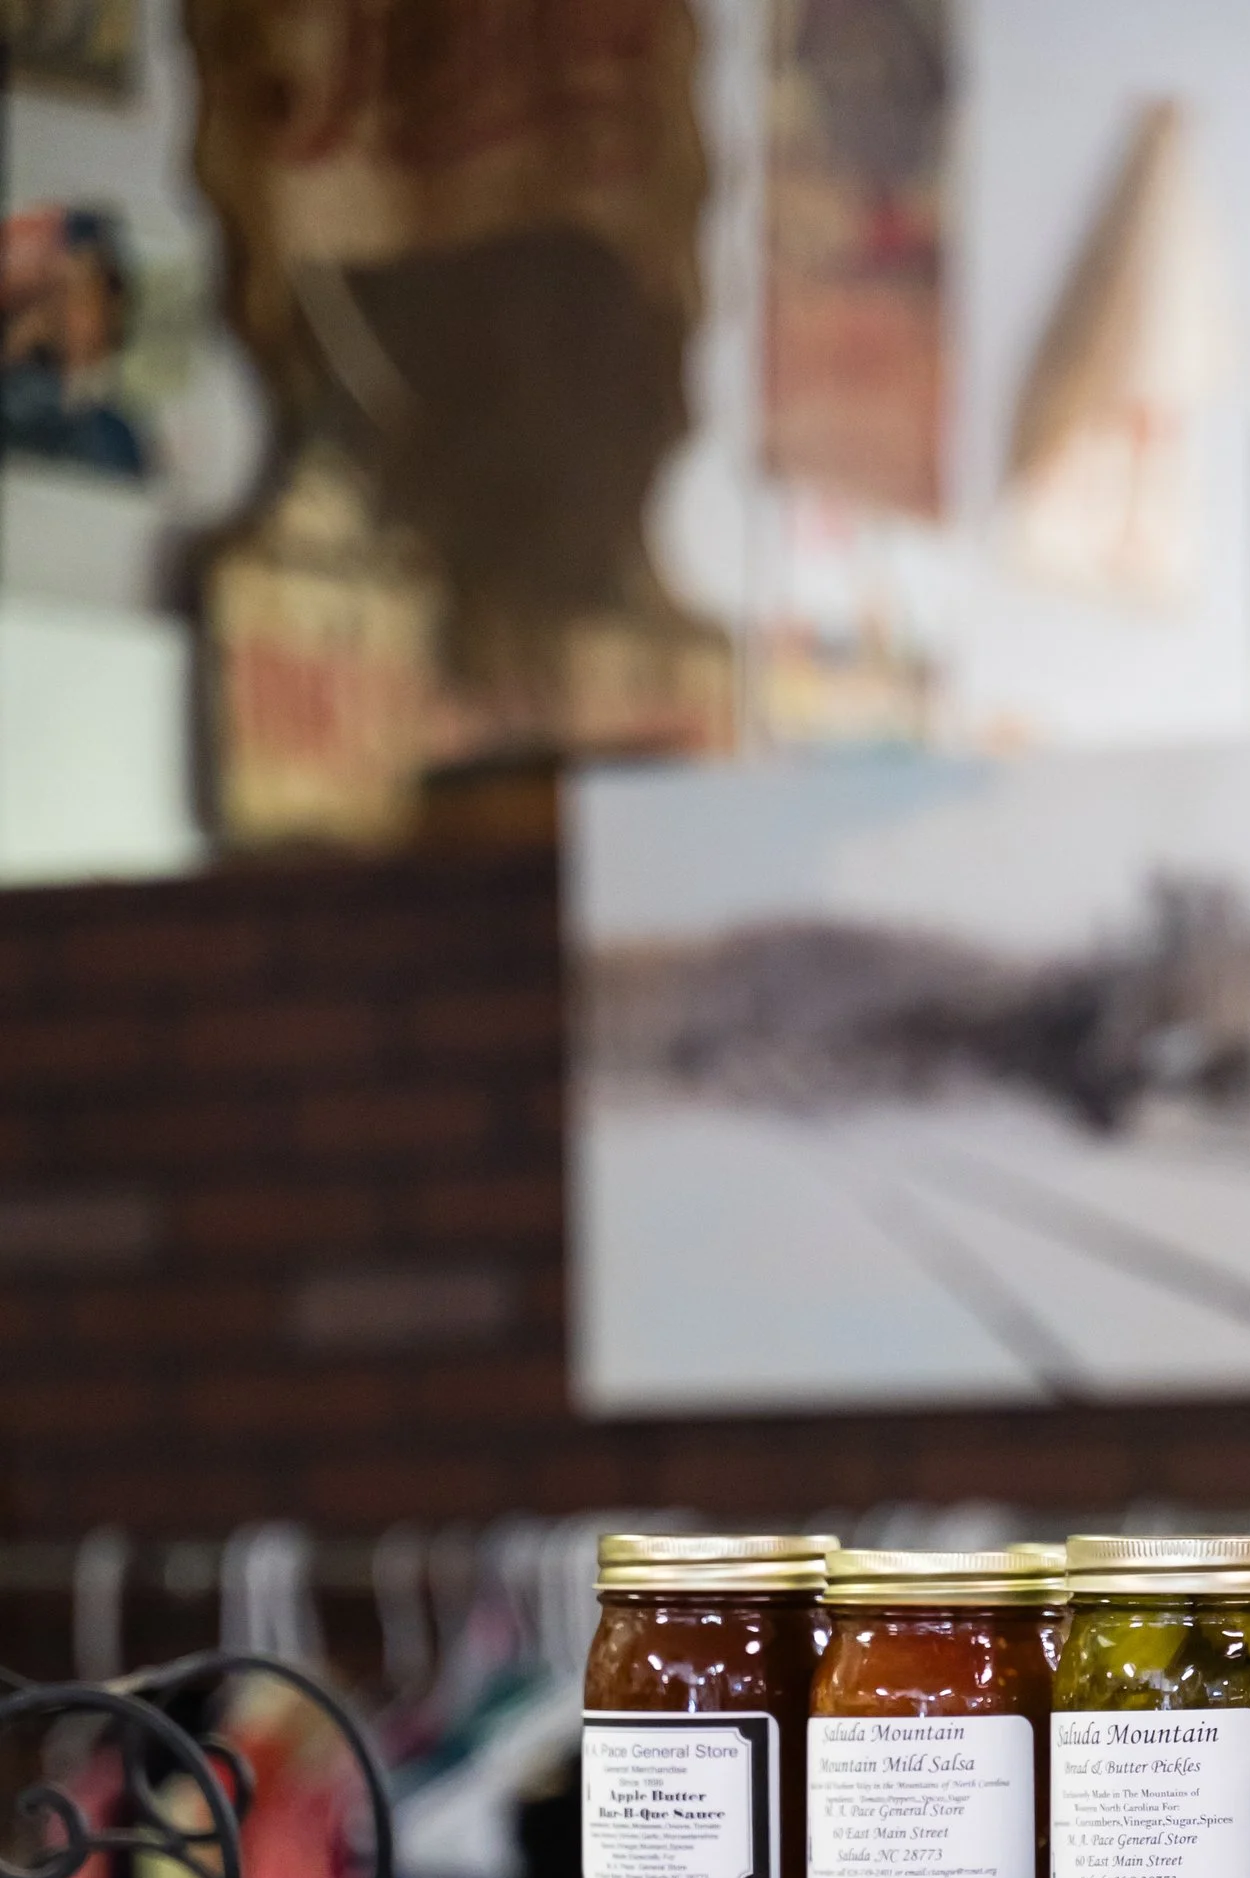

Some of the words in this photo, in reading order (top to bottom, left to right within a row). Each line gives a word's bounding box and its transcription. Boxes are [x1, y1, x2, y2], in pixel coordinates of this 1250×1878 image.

[870, 1723, 965, 1742] Mountain
[1057, 1722, 1100, 1747] Saluda
[1107, 1721, 1219, 1745] Mountain
[633, 1744, 689, 1758] General
[695, 1744, 738, 1758] Store
[883, 1754, 928, 1773] Mild
[928, 1753, 975, 1773] Salsa
[1107, 1761, 1148, 1774] Butter
[1151, 1757, 1201, 1775] Pickles
[609, 1790, 647, 1803] Apple
[652, 1790, 707, 1801] Butter
[1141, 1789, 1187, 1797] Mountains
[599, 1807, 669, 1820] Bar-B-Que
[674, 1807, 725, 1819] Sauce
[852, 1803, 875, 1817] Pace
[879, 1800, 928, 1821] General
[929, 1803, 965, 1816] Store
[1123, 1803, 1159, 1811] Carolina
[846, 1829, 869, 1839] East
[873, 1827, 907, 1839] Main
[910, 1826, 949, 1840] Street
[1092, 1834, 1114, 1846] Pace
[1117, 1832, 1164, 1850] General
[1164, 1833, 1198, 1845] Store
[903, 1849, 943, 1862] 28773
[1087, 1856, 1109, 1867] East
[1112, 1855, 1143, 1867] Main
[1146, 1855, 1183, 1867] Street
